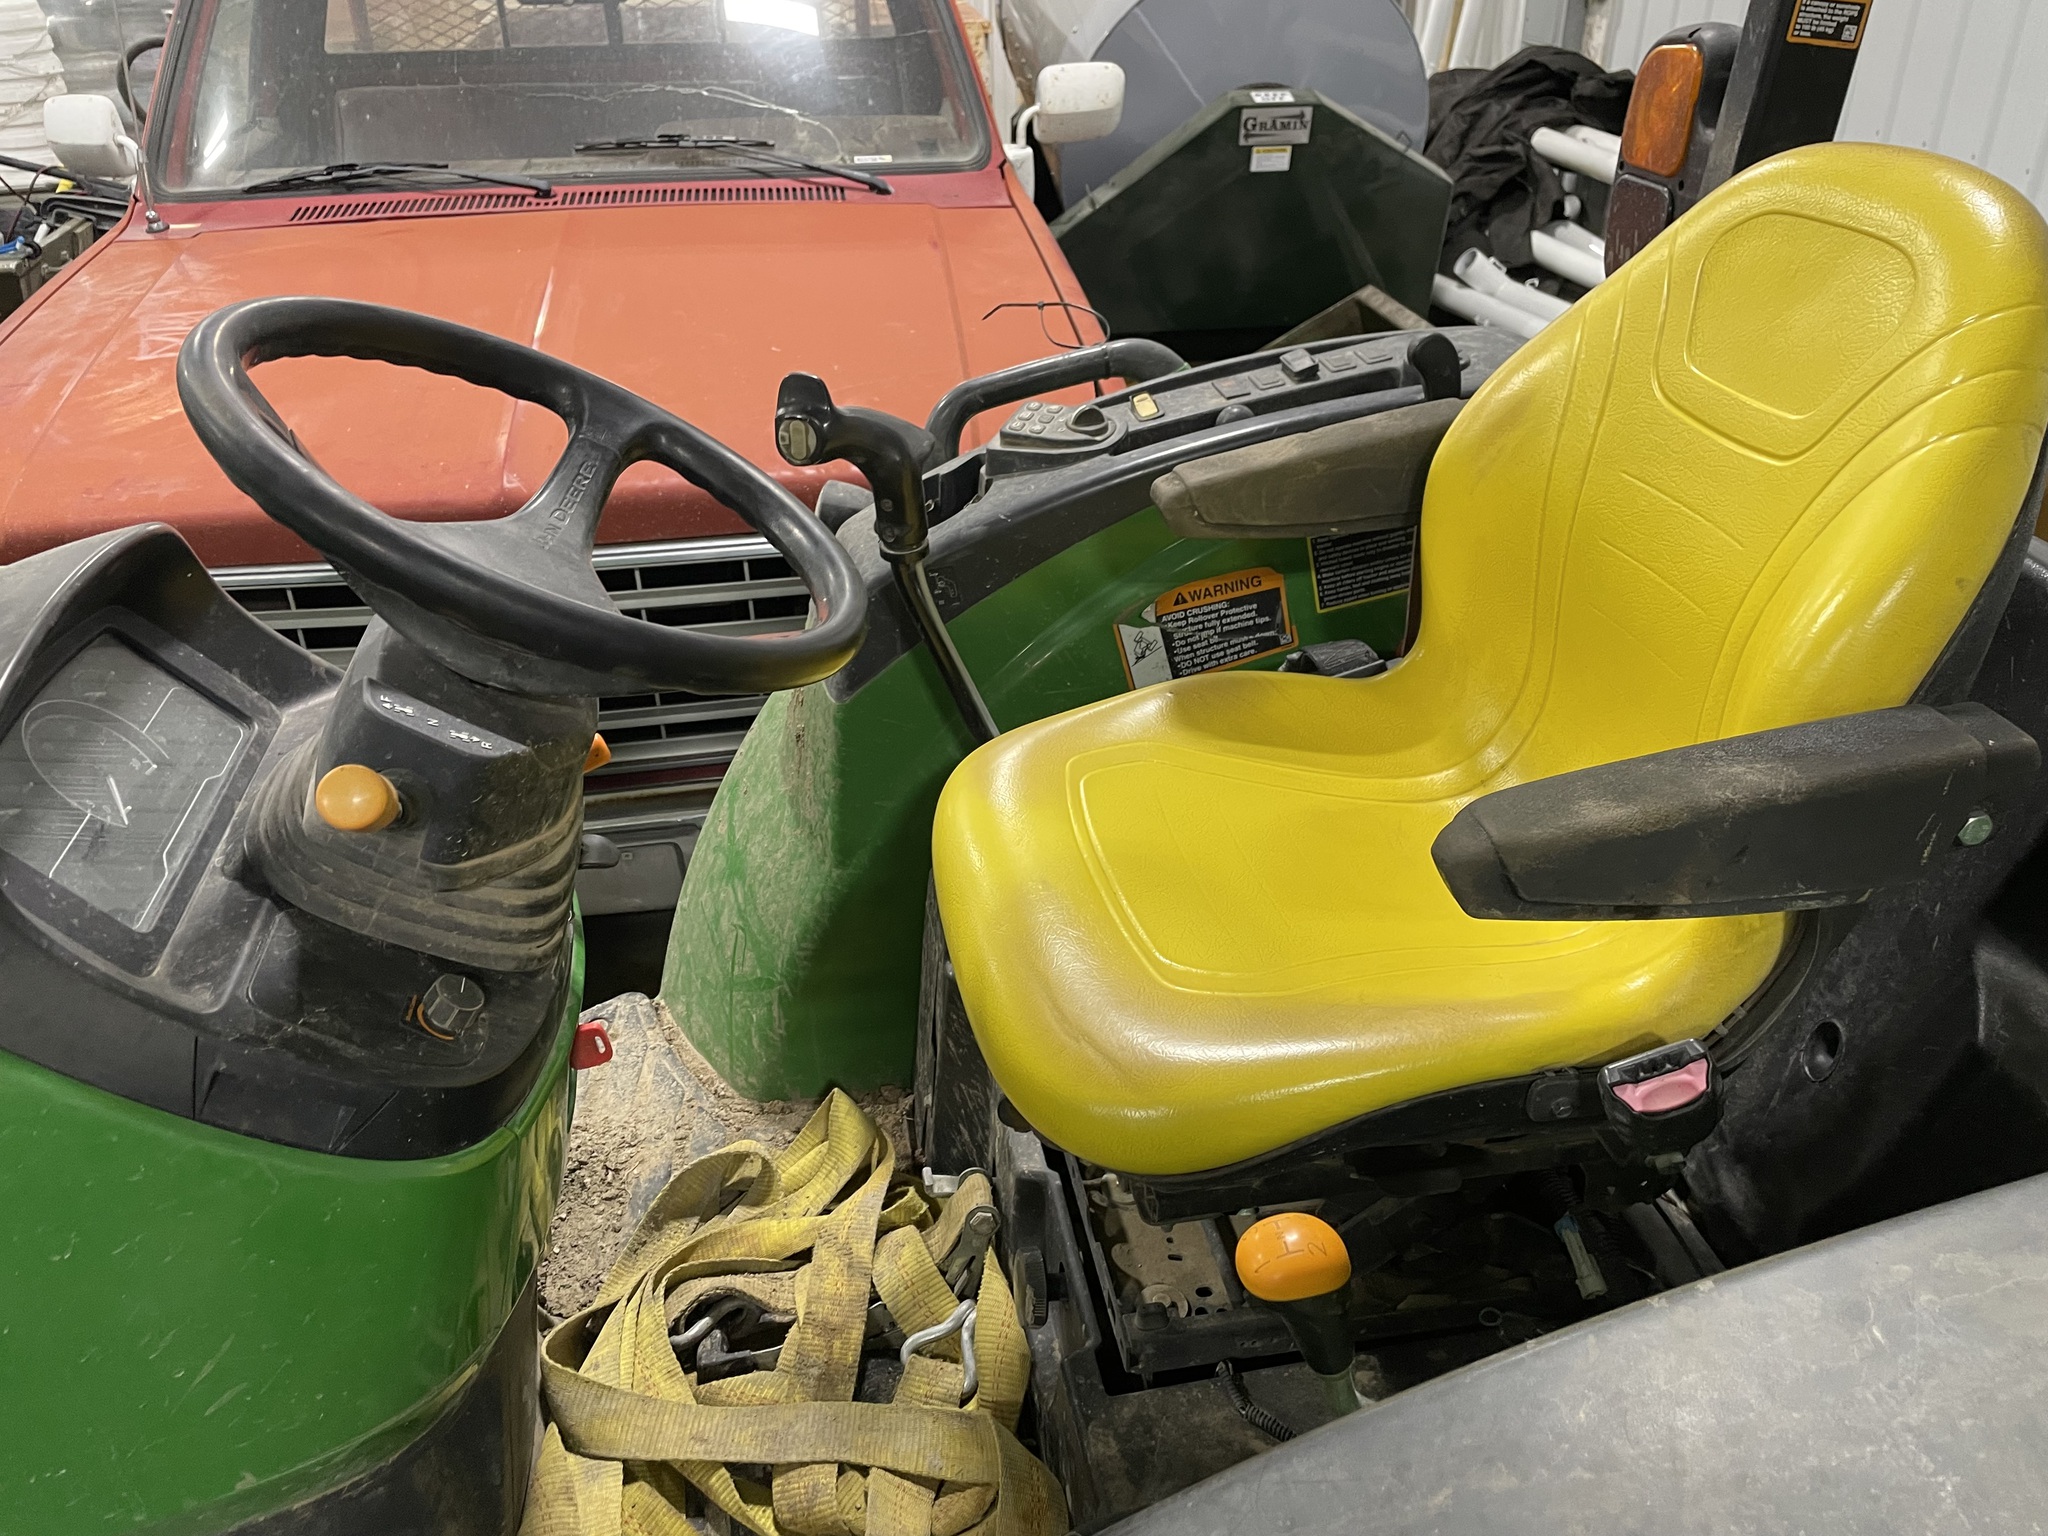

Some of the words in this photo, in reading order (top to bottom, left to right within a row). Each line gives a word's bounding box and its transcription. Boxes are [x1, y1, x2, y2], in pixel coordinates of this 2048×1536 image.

[549, 460, 599, 525] DEERE
[1188, 575, 1262, 602] WARNING
[1162, 612, 1185, 622] AVOID
[1186, 601, 1230, 616] CRUSHING:
[1167, 618, 1186, 630] Keep
[1187, 612, 1219, 624] Rollover
[1220, 603, 1258, 616] Protective
[1204, 619, 1220, 632] fully
[1221, 610, 1258, 623] extended.
[1175, 640, 1186, 648] Do
[1187, 635, 1199, 645] not
[1223, 620, 1254, 632] machine
[1255, 616, 1271, 627] tips.
[1174, 653, 1194, 663] When
[1196, 642, 1228, 656] structure
[1177, 646, 1191, 655] Use
[1192, 641, 1209, 651] seat
[1180, 660, 1193, 669] DO
[1194, 655, 1209, 665] NOT
[1211, 651, 1225, 660] use
[1225, 647, 1241, 656] seat
[1243, 641, 1259, 650] belt.
[1182, 667, 1201, 676] Drive
[1202, 661, 1219, 671] with
[1220, 655, 1238, 665] extra
[1240, 649, 1257, 659] care.
[1307, 1241, 1328, 1257] 2
